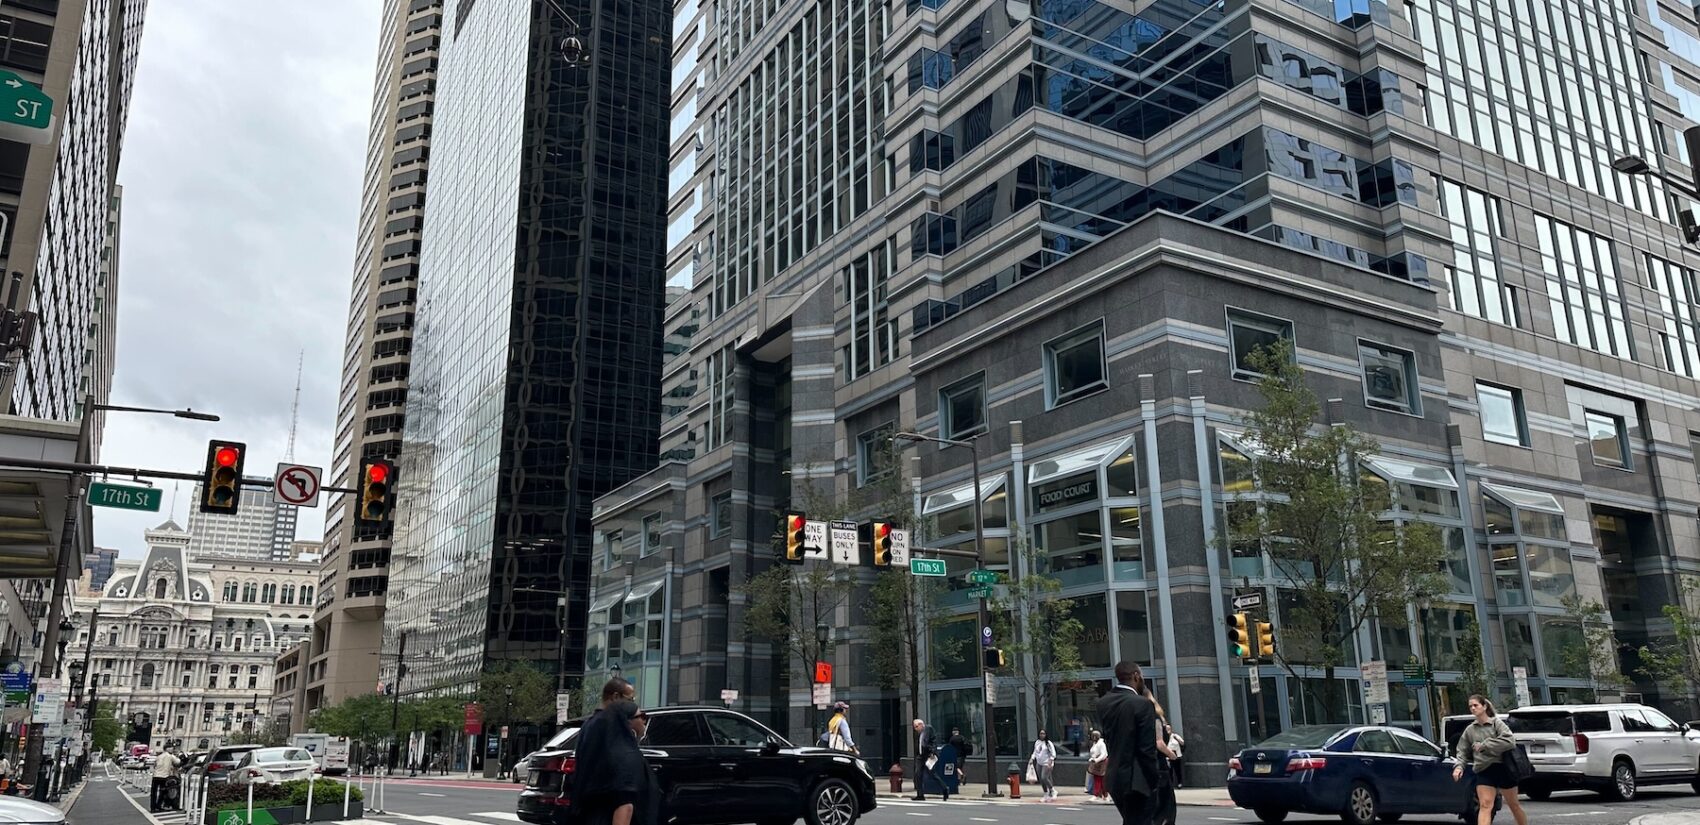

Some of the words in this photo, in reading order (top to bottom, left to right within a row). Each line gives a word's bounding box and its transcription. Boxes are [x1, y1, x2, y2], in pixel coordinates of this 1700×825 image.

[14, 99, 42, 120] ST
[102, 488, 131, 504] 17th
[134, 492, 149, 506] St
[1040, 490, 1062, 505] FOOD
[1063, 482, 1091, 498] COURT
[805, 524, 822, 534] ONE
[805, 534, 823, 543] WAY
[833, 531, 856, 541] BUSES
[891, 532, 903, 542] NO
[835, 541, 854, 550] ONLY
[917, 562, 932, 572] 17th
[932, 563, 940, 573] St
